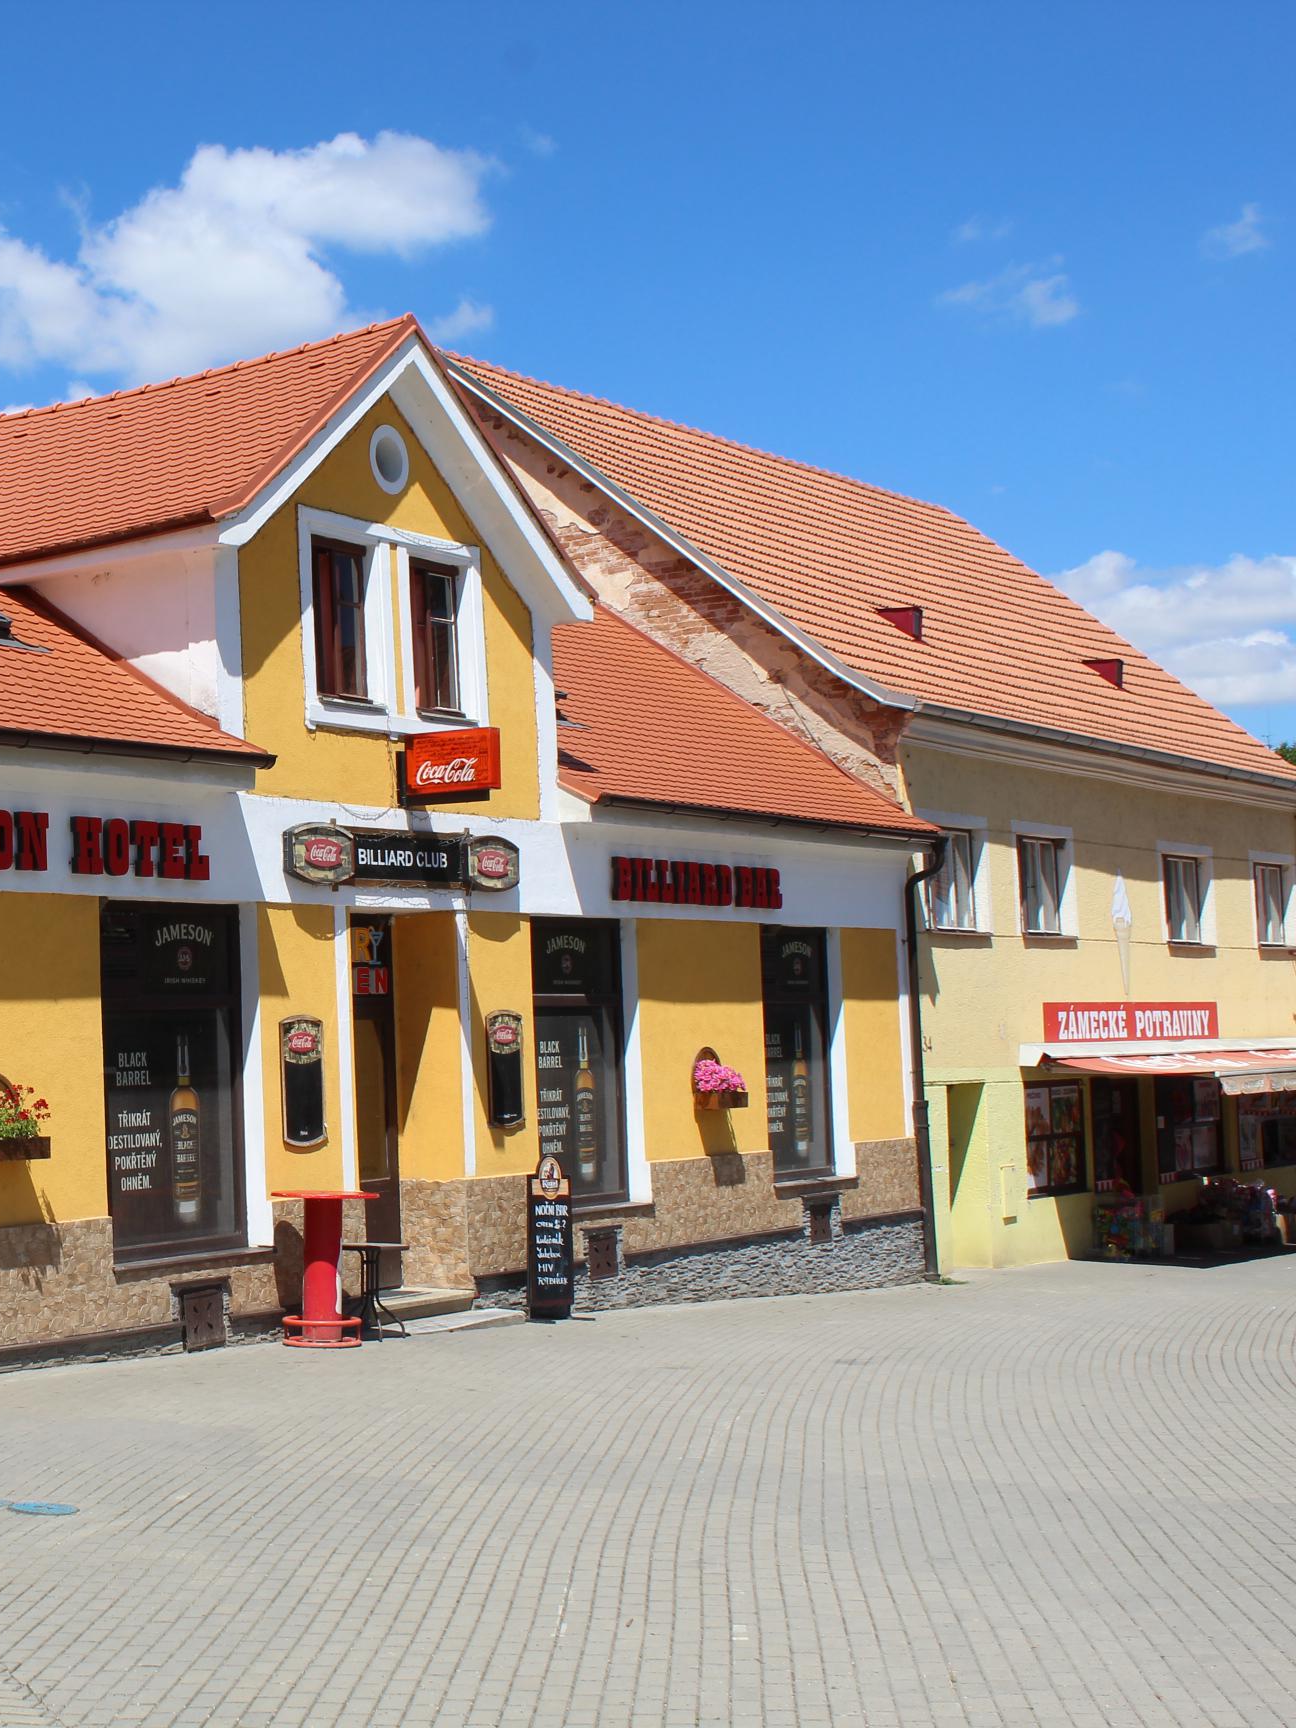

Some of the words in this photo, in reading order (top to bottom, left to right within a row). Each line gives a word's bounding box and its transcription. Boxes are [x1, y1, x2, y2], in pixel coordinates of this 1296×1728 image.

[416, 757, 479, 785] Coca-Cola
[70, 816, 210, 881] HOTEL
[310, 844, 337, 862] Coca-Cola
[358, 848, 414, 867] BILLIARD
[416, 851, 448, 868] CLUB
[481, 856, 504, 872] Coca-Cola
[611, 856, 732, 907] BILLIARD
[733, 865, 783, 910] BAR
[155, 923, 212, 947] JAMESON
[546, 935, 585, 954] JAMESON
[1058, 1004, 1128, 1040] ZÁMECKÉ
[1134, 1009, 1210, 1038] POTRAVINY
[539, 1040, 560, 1054] BLACK
[118, 1052, 147, 1068] BLACK
[538, 1056, 563, 1069] BARREL
[116, 1070, 151, 1086] BARREL
[540, 1088, 563, 1102] TŘIKRÁT
[118, 1109, 151, 1127] TŘIKRÁT
[172, 1113, 197, 1126] JAMESON
[537, 1104, 570, 1120] ESTILOVANÝ,
[115, 1151, 157, 1171] POKŘTĚNÝ
[121, 1172, 152, 1191] OHNĚM.
